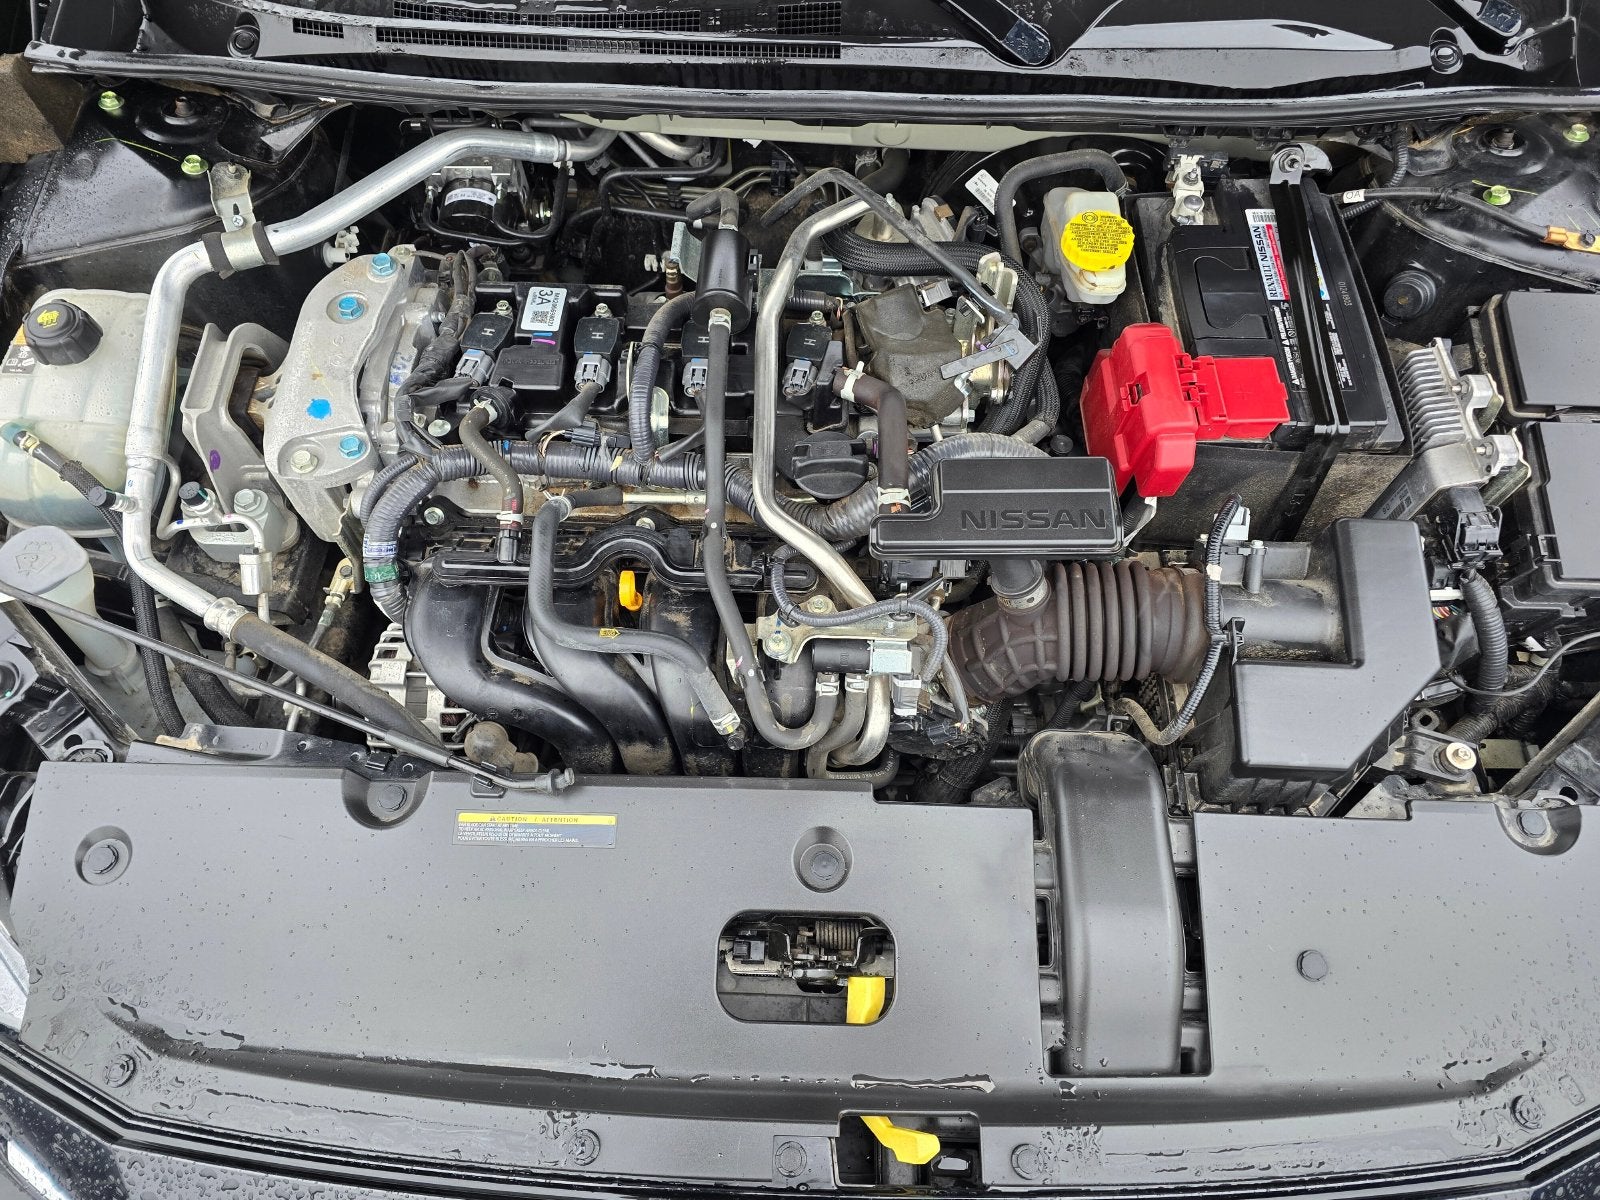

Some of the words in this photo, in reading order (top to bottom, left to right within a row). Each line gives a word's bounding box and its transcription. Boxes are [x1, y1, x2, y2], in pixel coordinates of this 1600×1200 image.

[1252, 225, 1270, 263] NISSAN
[1262, 264, 1279, 299] RENAULT
[536, 288, 554, 306] 3A
[960, 508, 1107, 531] NISSAN
[541, 816, 579, 824] ATTENTION
